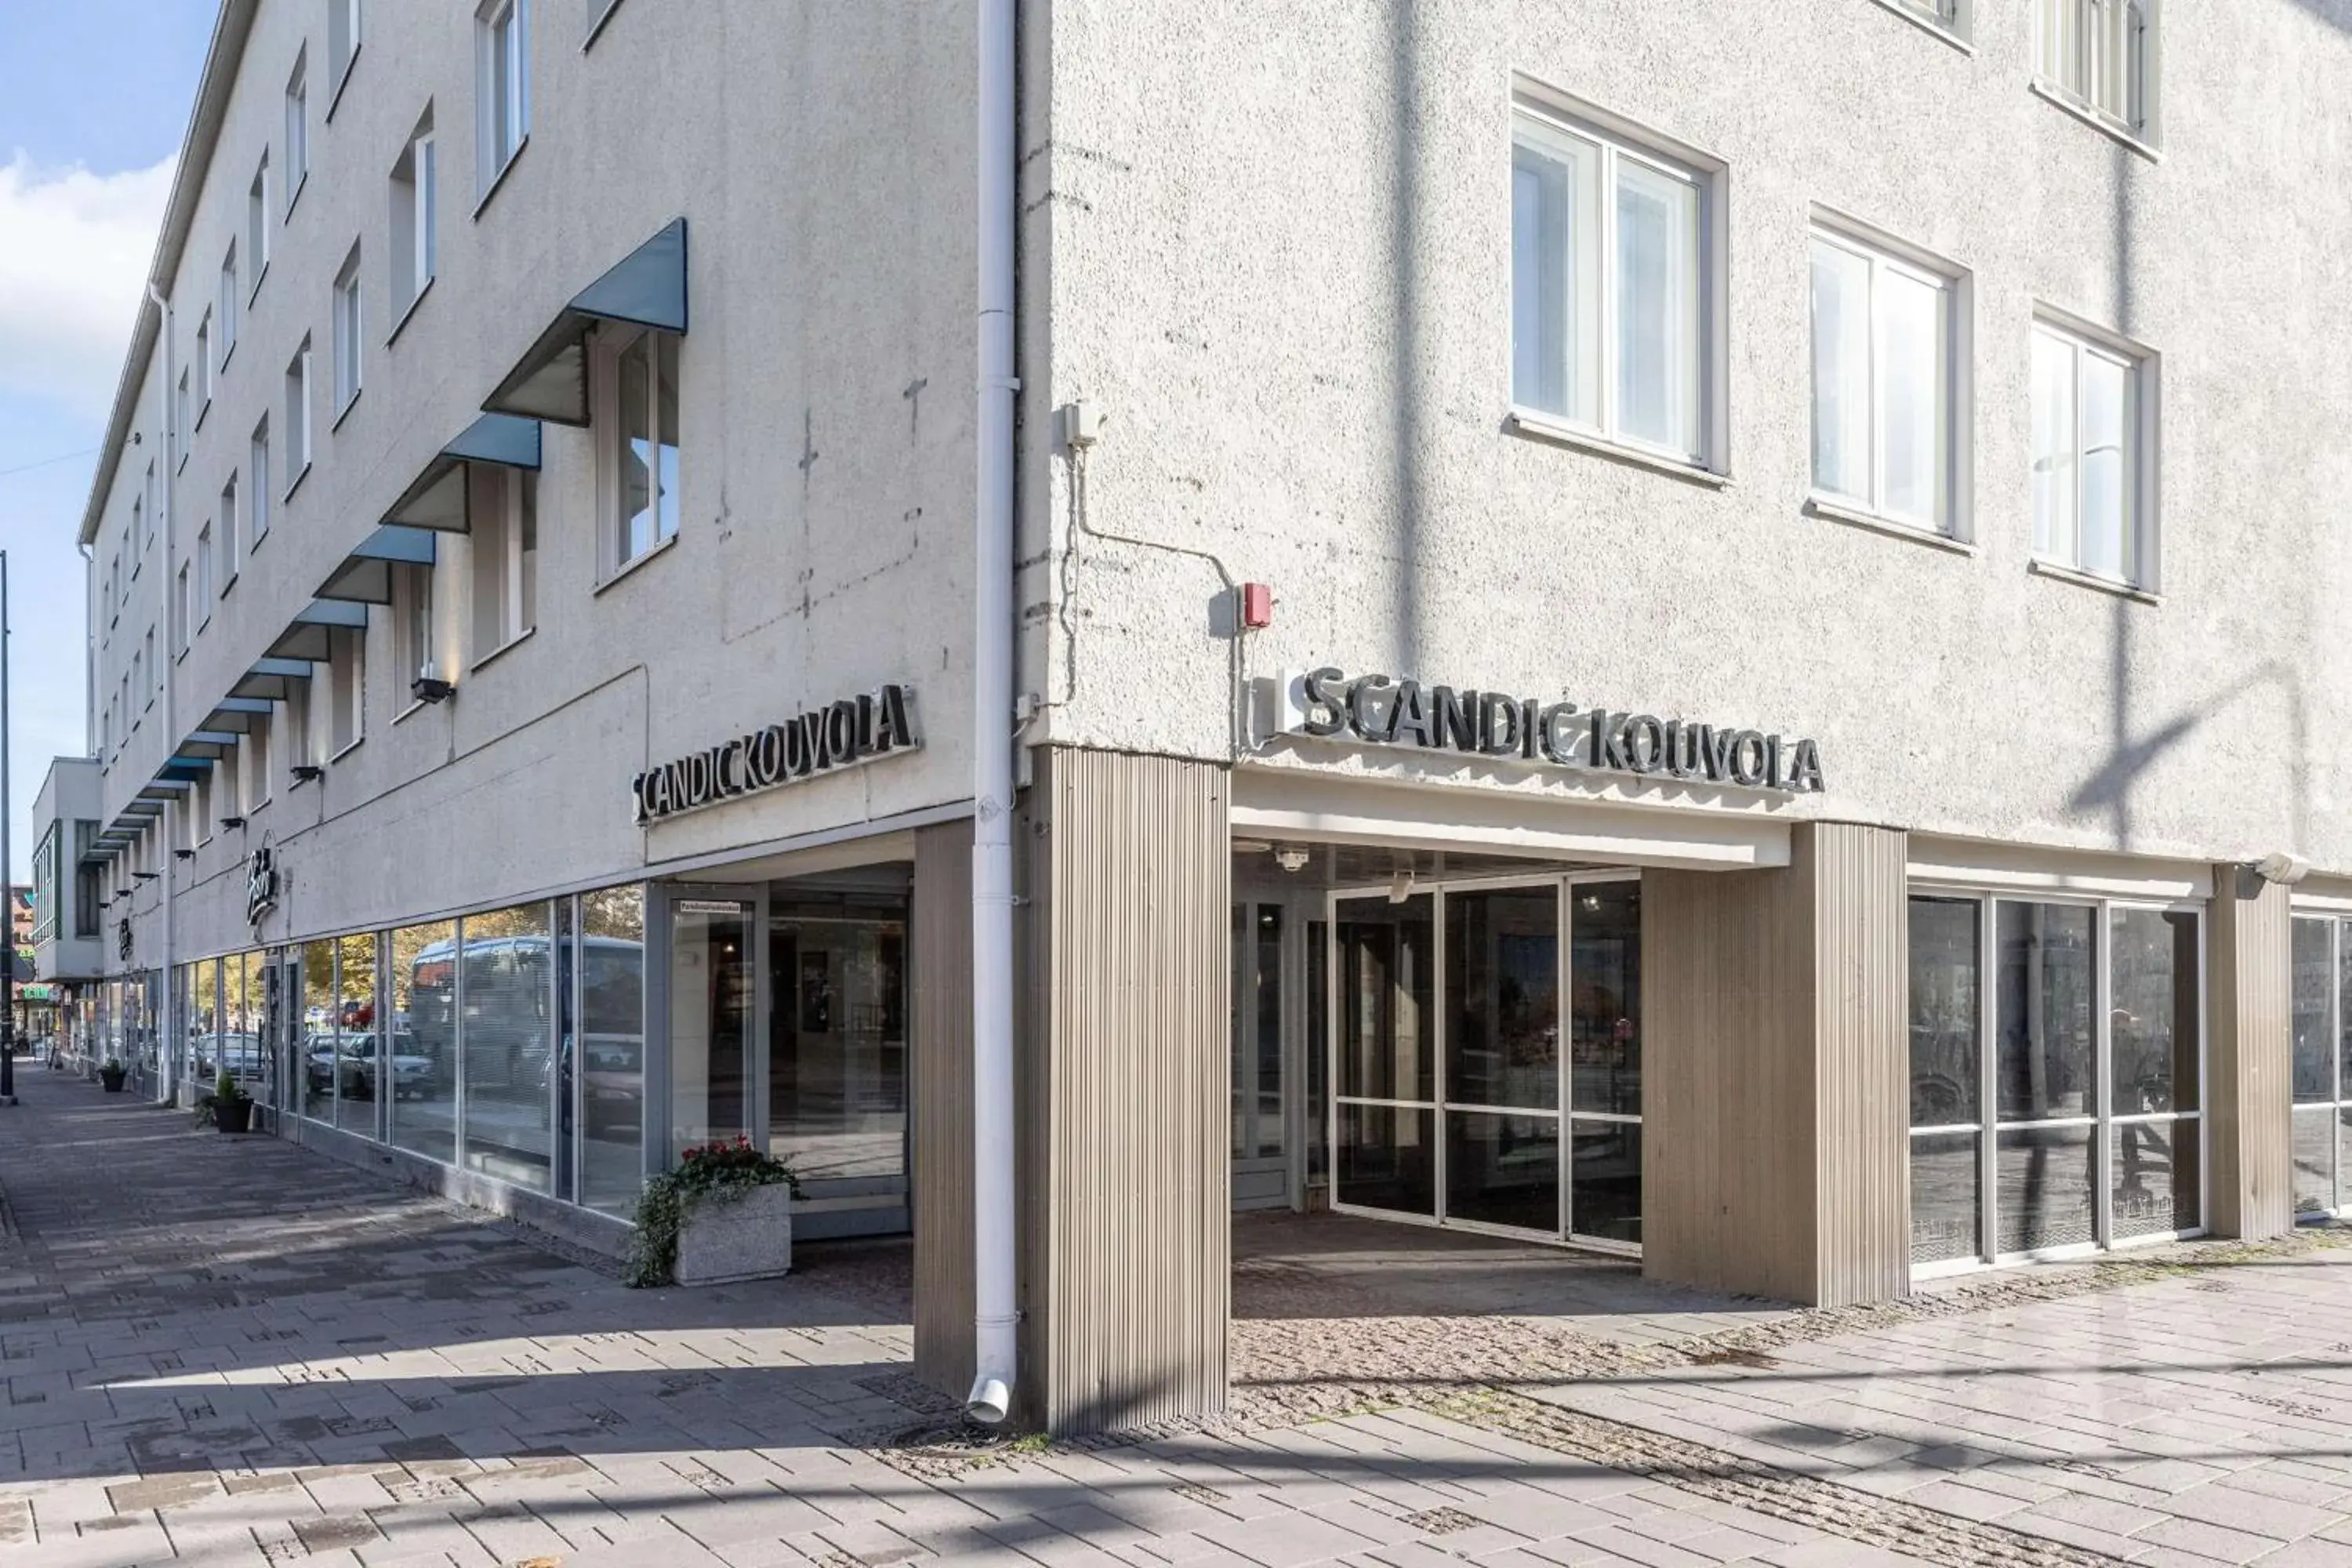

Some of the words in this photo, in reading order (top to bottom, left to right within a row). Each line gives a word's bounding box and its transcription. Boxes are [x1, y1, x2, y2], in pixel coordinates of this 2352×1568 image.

[632, 739, 743, 823] SCANDIC
[741, 684, 913, 791] KOUVOLA
[1303, 666, 1577, 765] SCANDIC
[1589, 707, 1825, 792] KOUVOLA
